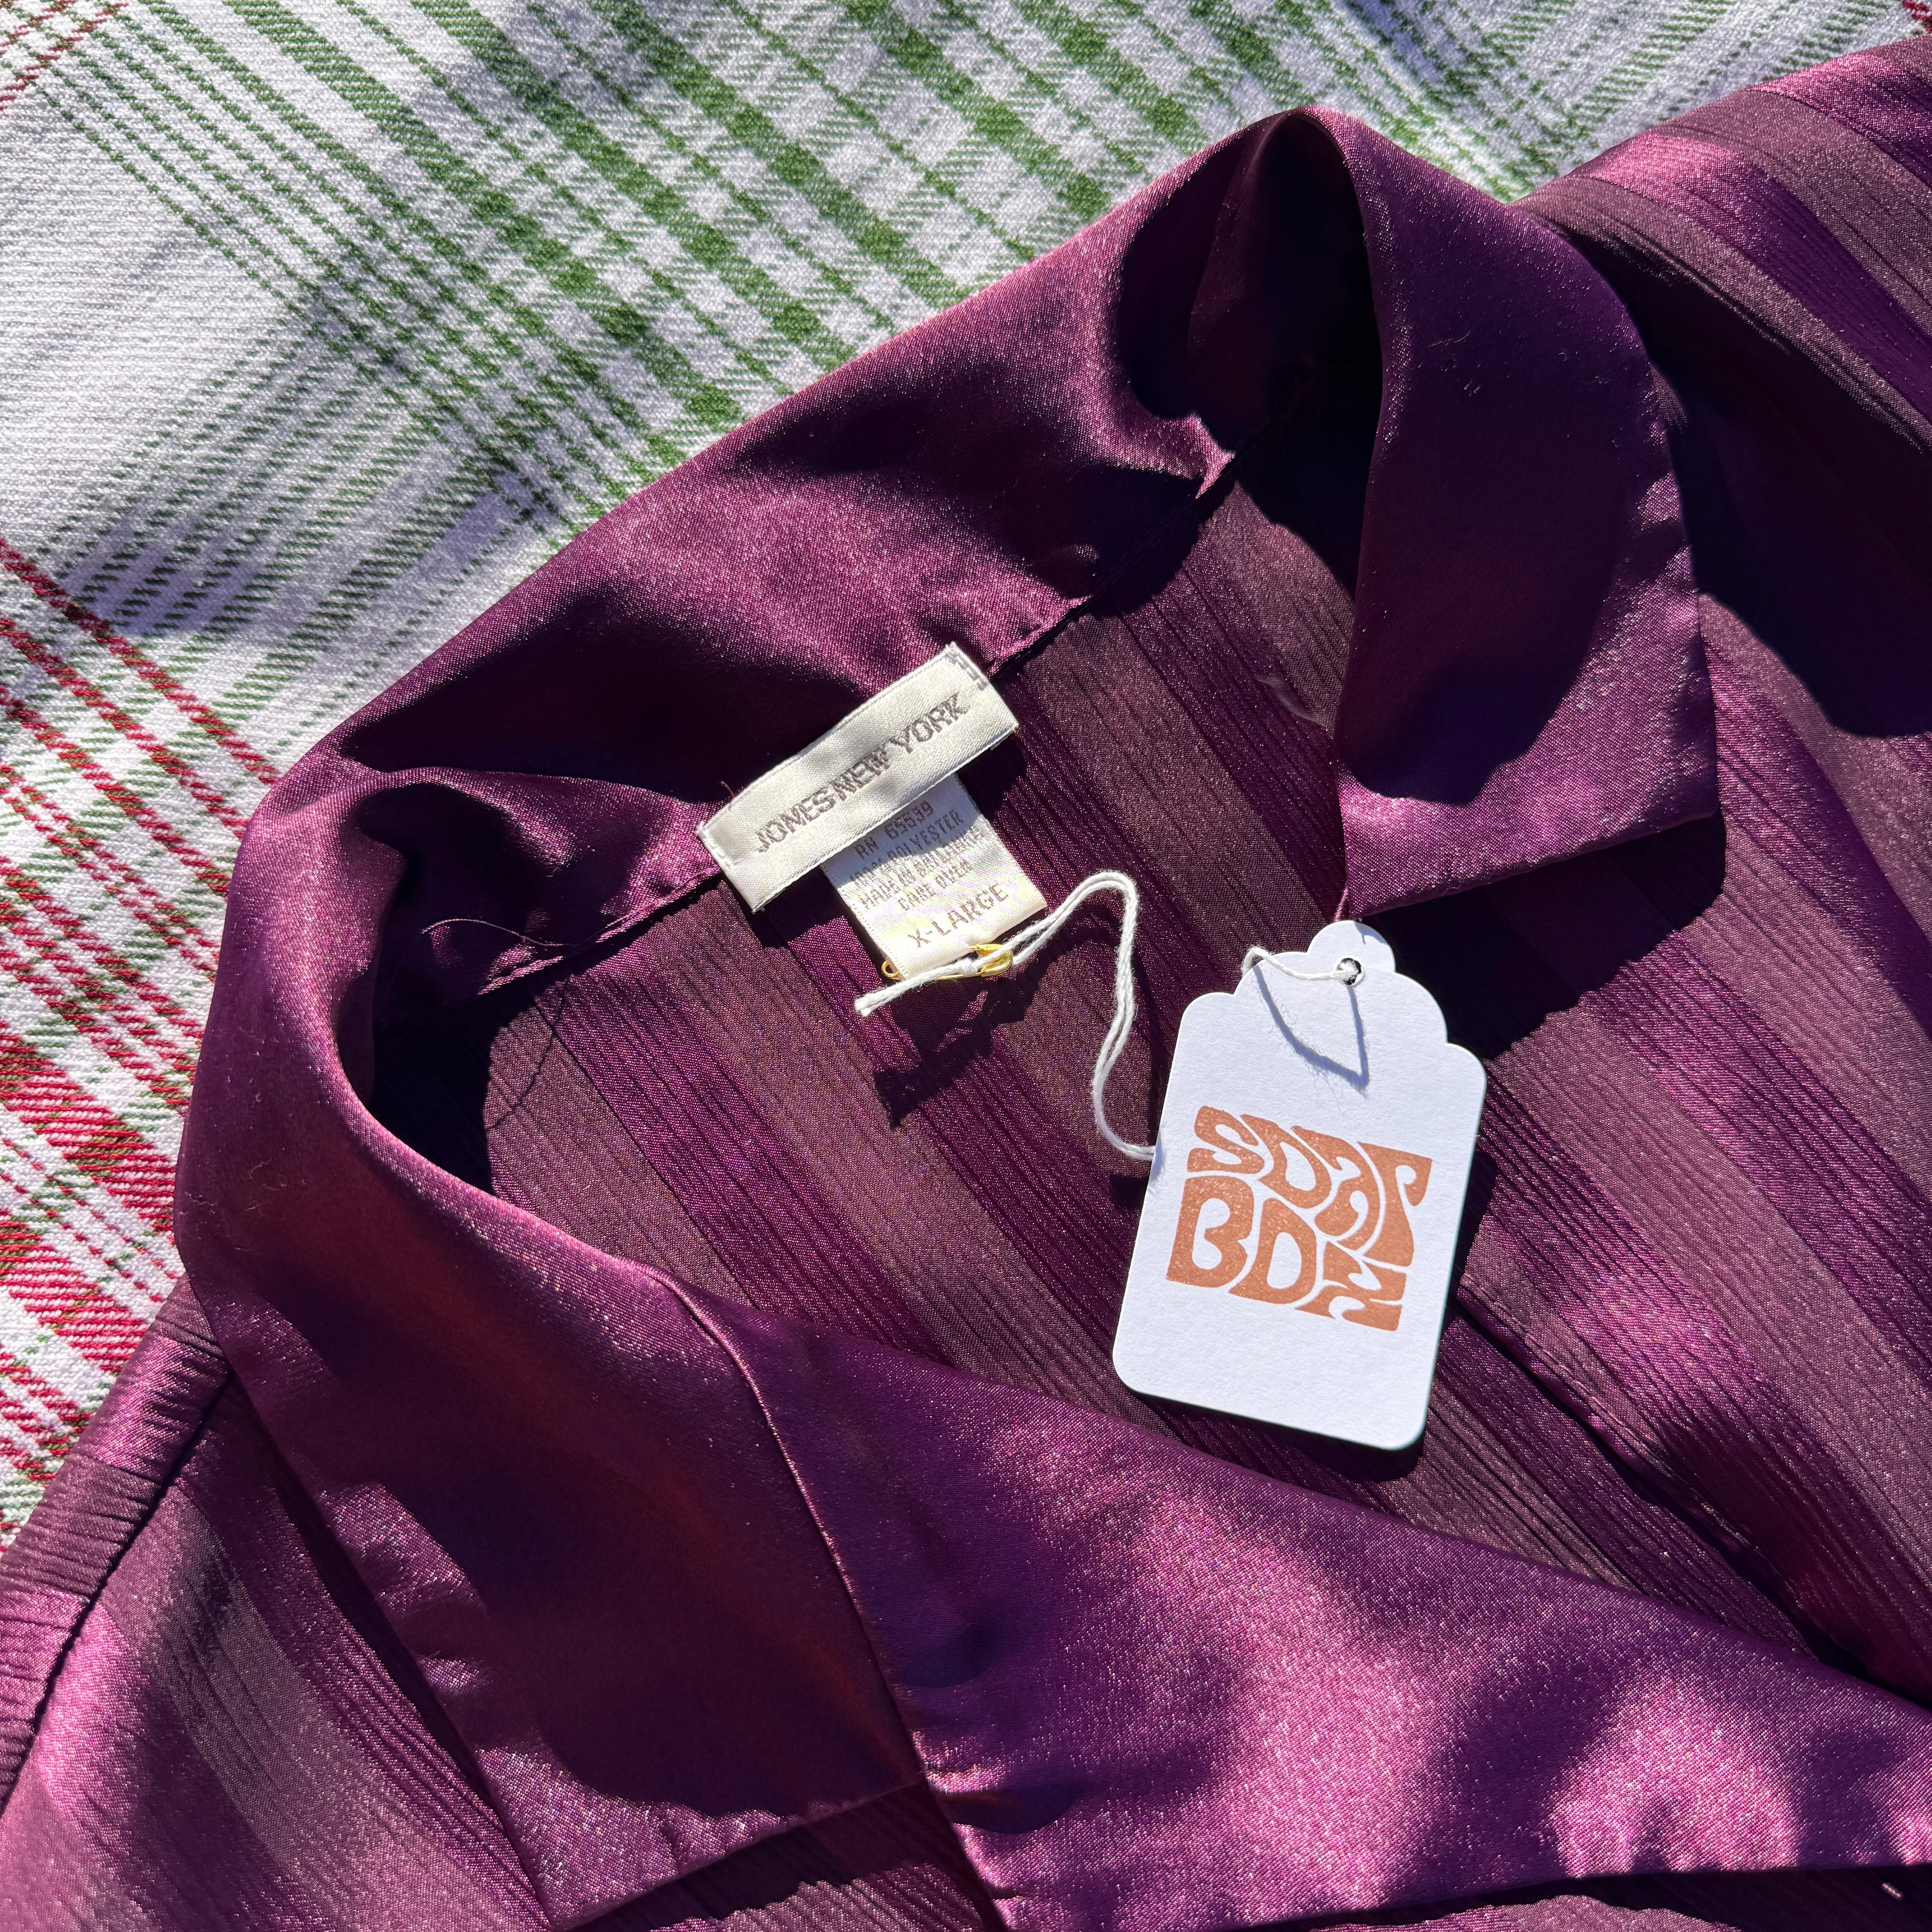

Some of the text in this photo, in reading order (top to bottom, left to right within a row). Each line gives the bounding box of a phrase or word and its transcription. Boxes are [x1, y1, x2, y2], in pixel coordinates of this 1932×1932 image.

[755, 692, 970, 852] JONES NEW YORK
[855, 837, 879, 860] RN
[887, 809, 964, 865] POLYESTER
[859, 878, 901, 911] MADE
[907, 884, 1010, 948] X-LARGE
